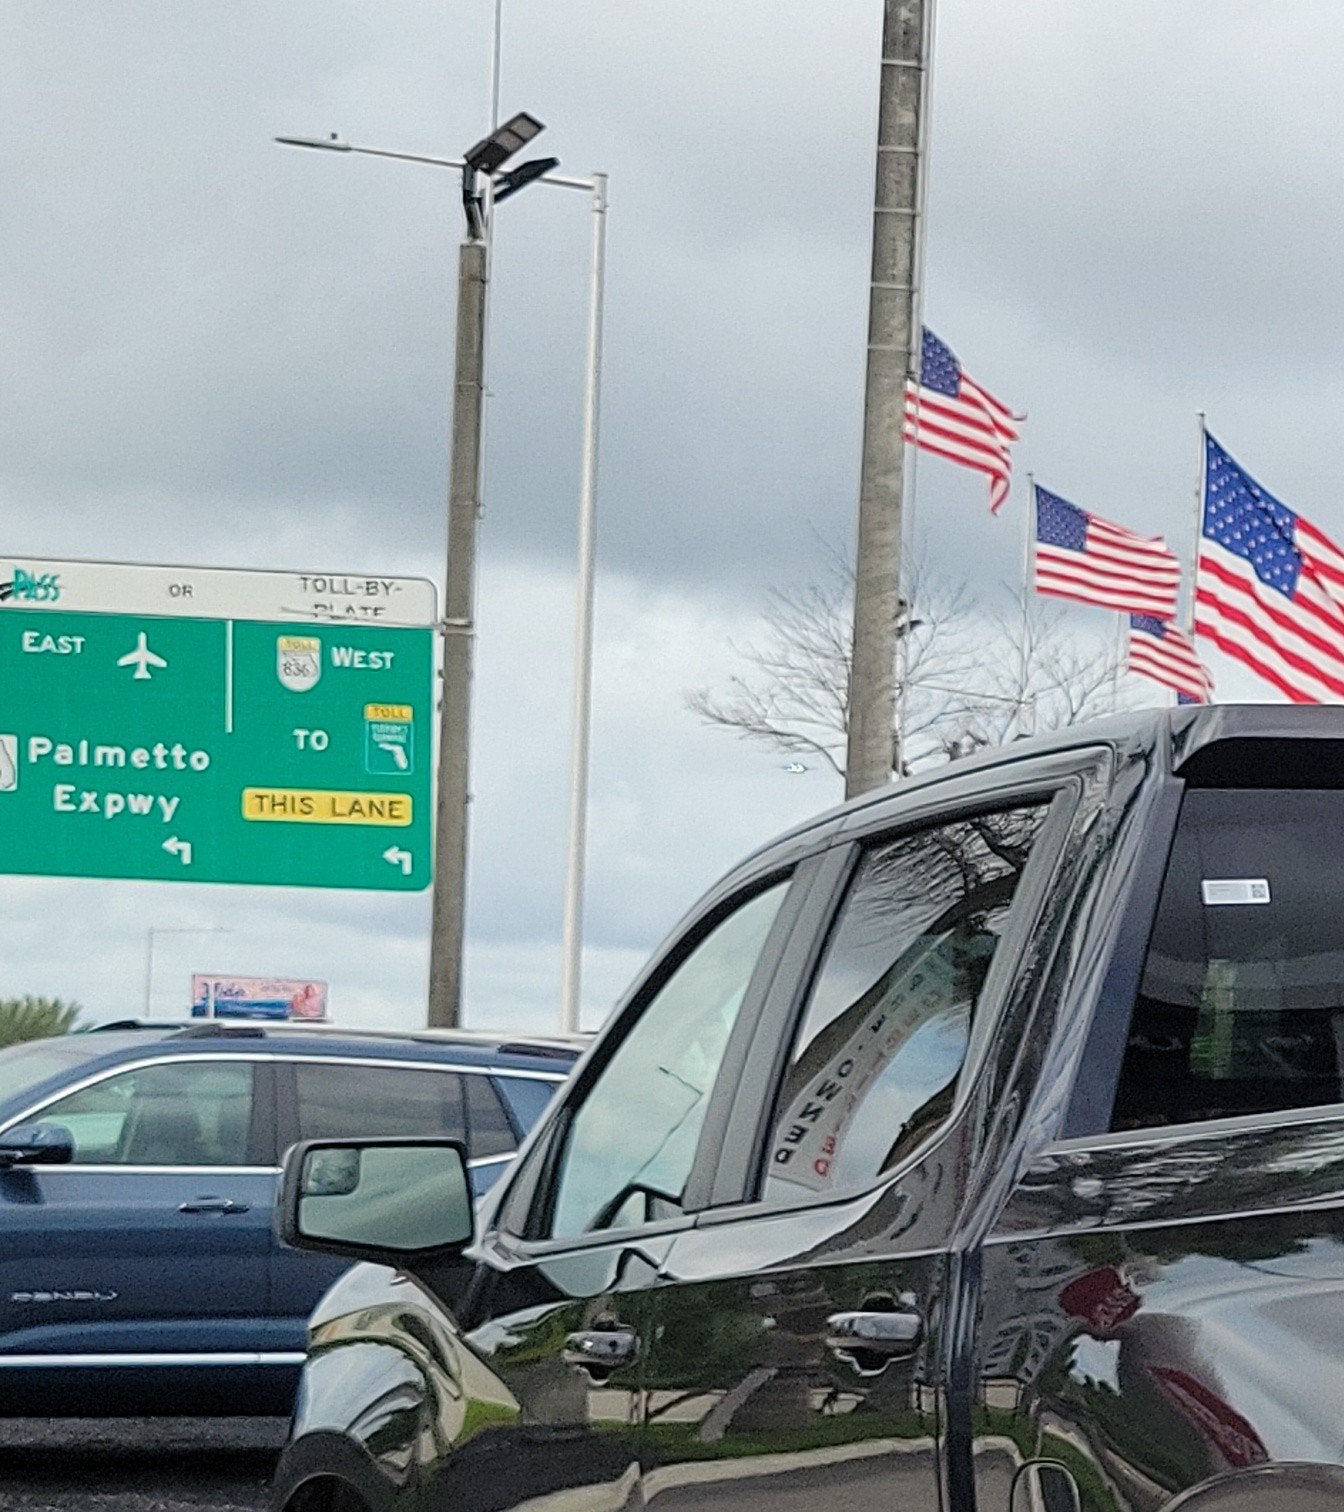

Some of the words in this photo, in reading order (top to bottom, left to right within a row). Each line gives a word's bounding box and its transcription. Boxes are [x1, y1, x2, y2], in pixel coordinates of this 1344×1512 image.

[169, 584, 193, 598] OR
[22, 631, 86, 654] EAST
[331, 646, 395, 669] WEST
[292, 729, 329, 751] TO
[29, 736, 210, 772] Palmetto
[53, 783, 180, 822] Expwy
[255, 795, 314, 815] THIS
[332, 797, 404, 819] LANE
